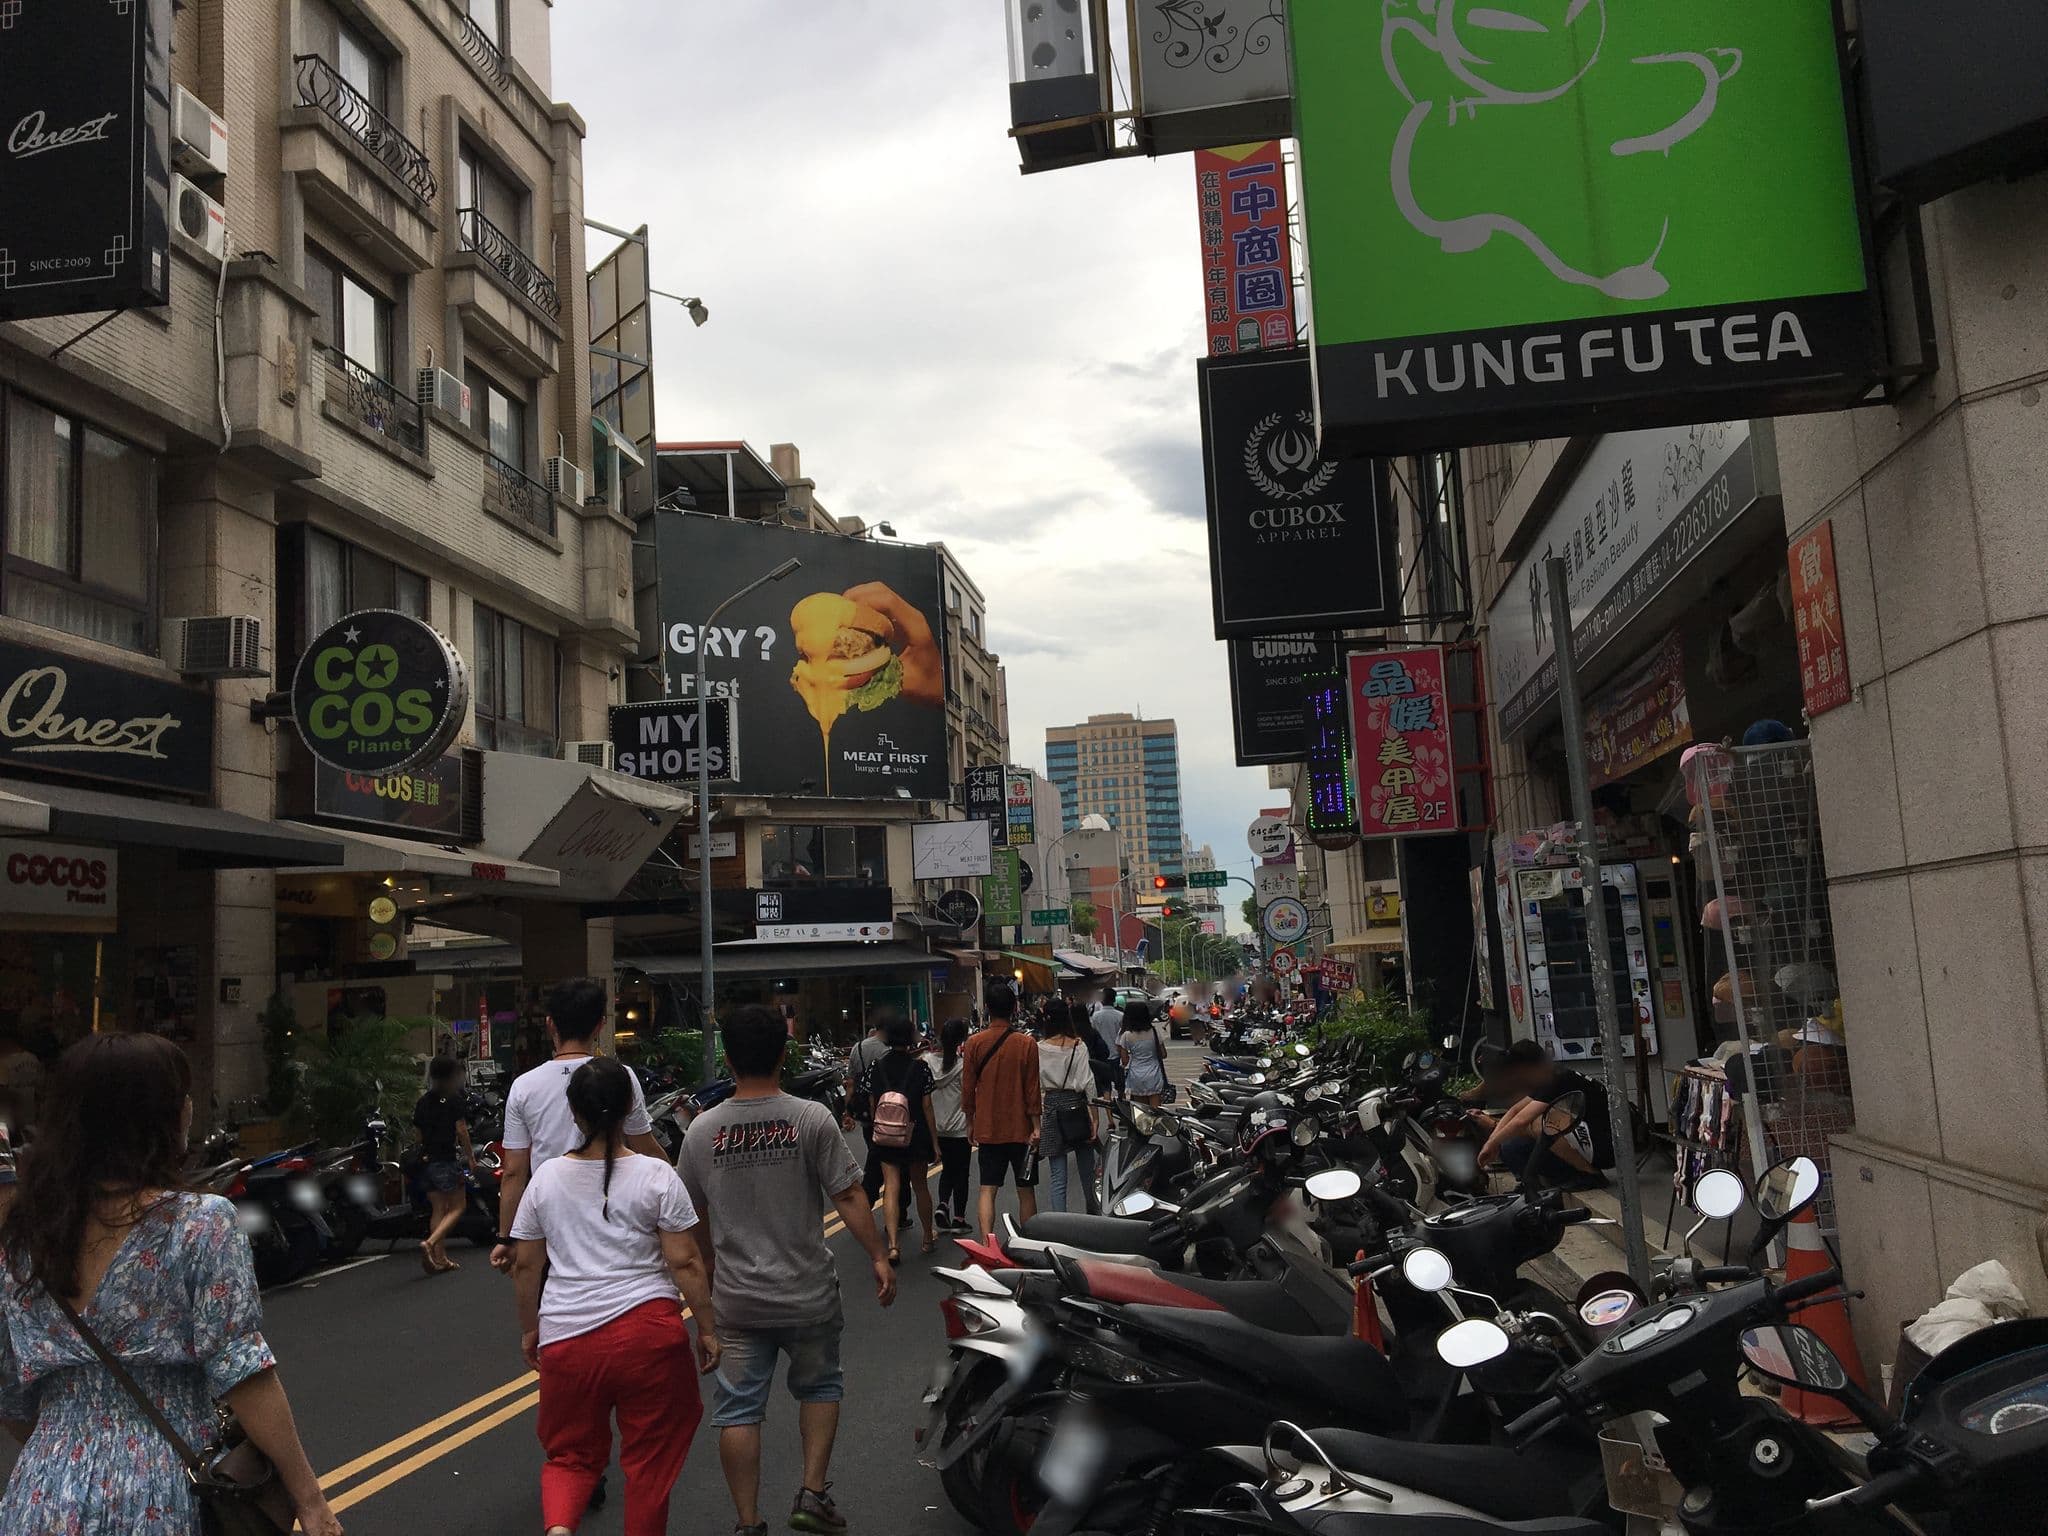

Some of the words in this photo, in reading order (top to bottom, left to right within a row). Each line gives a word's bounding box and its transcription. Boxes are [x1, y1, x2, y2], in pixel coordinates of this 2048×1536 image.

[8, 110, 118, 158] Quest
[1201, 171, 1229, 323] 在地精耕十年有成
[1227, 162, 1287, 314] 一中商圈
[29, 257, 61, 272] SINCE
[63, 256, 92, 268] 2009
[1248, 502, 1347, 530] CUBOX
[1256, 527, 1340, 544] APPAREL
[1580, 553, 1612, 600] Fashion
[1610, 520, 1640, 564] Beauty
[662, 622, 747, 658] GRY
[754, 625, 777, 661] ?
[1259, 656, 1313, 668] APPAREL
[680, 672, 740, 698] Frst
[1264, 675, 1288, 688] SINCE
[0, 665, 182, 759] Quest
[639, 713, 699, 745] MY
[346, 738, 412, 754] Planet
[618, 746, 724, 776] SHOES
[843, 750, 884, 762] MEAT
[889, 753, 929, 764] FIRST
[854, 763, 880, 774] burger
[893, 766, 919, 775] snacks
[970, 770, 1001, 786] 艾斯
[970, 787, 1002, 803] 机膜
[1422, 801, 1447, 821] 2F
[7, 853, 106, 889] COCOS
[66, 889, 107, 905] Planet
[773, 928, 790, 937] EA7
